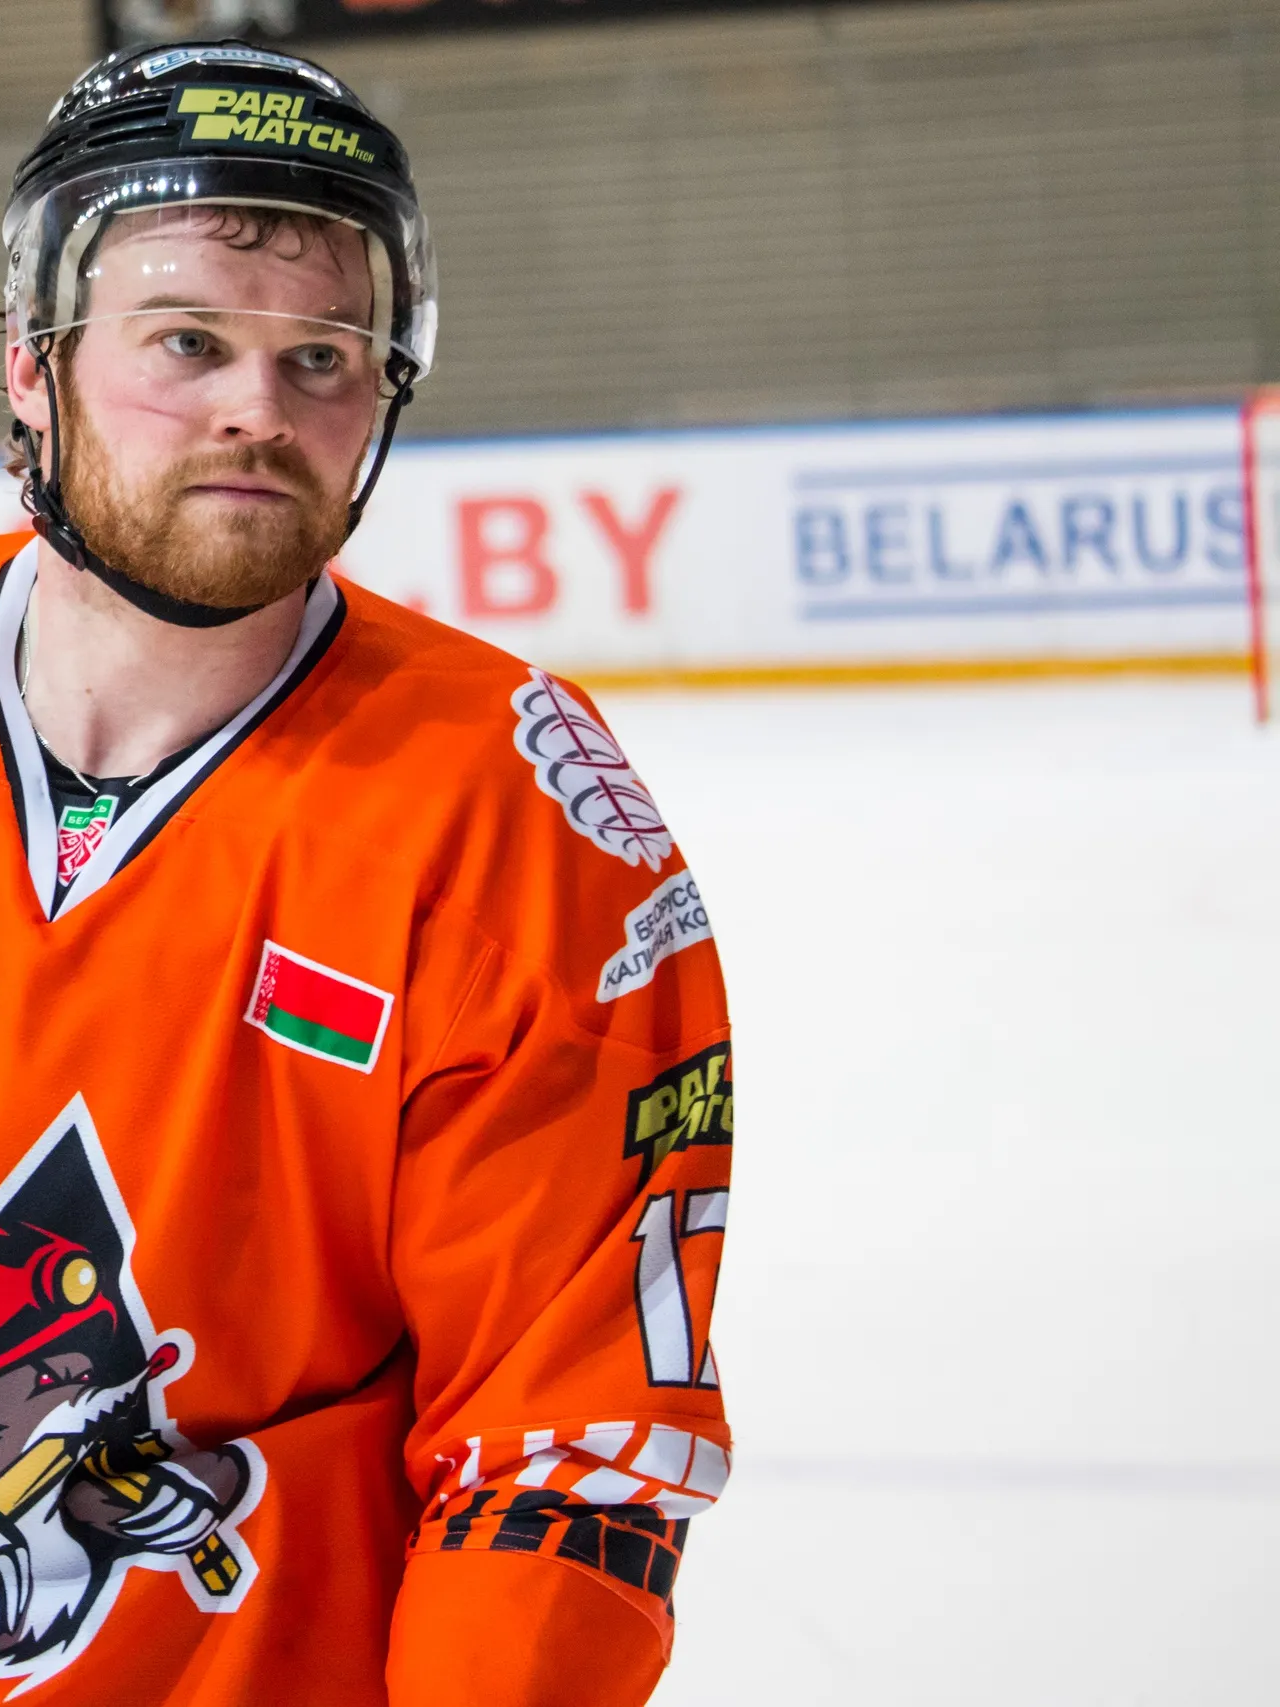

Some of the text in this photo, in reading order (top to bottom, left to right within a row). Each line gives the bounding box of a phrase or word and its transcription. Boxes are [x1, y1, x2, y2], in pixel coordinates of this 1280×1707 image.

[178, 89, 306, 120] PARI
[192, 114, 375, 163] MATCH TECH
